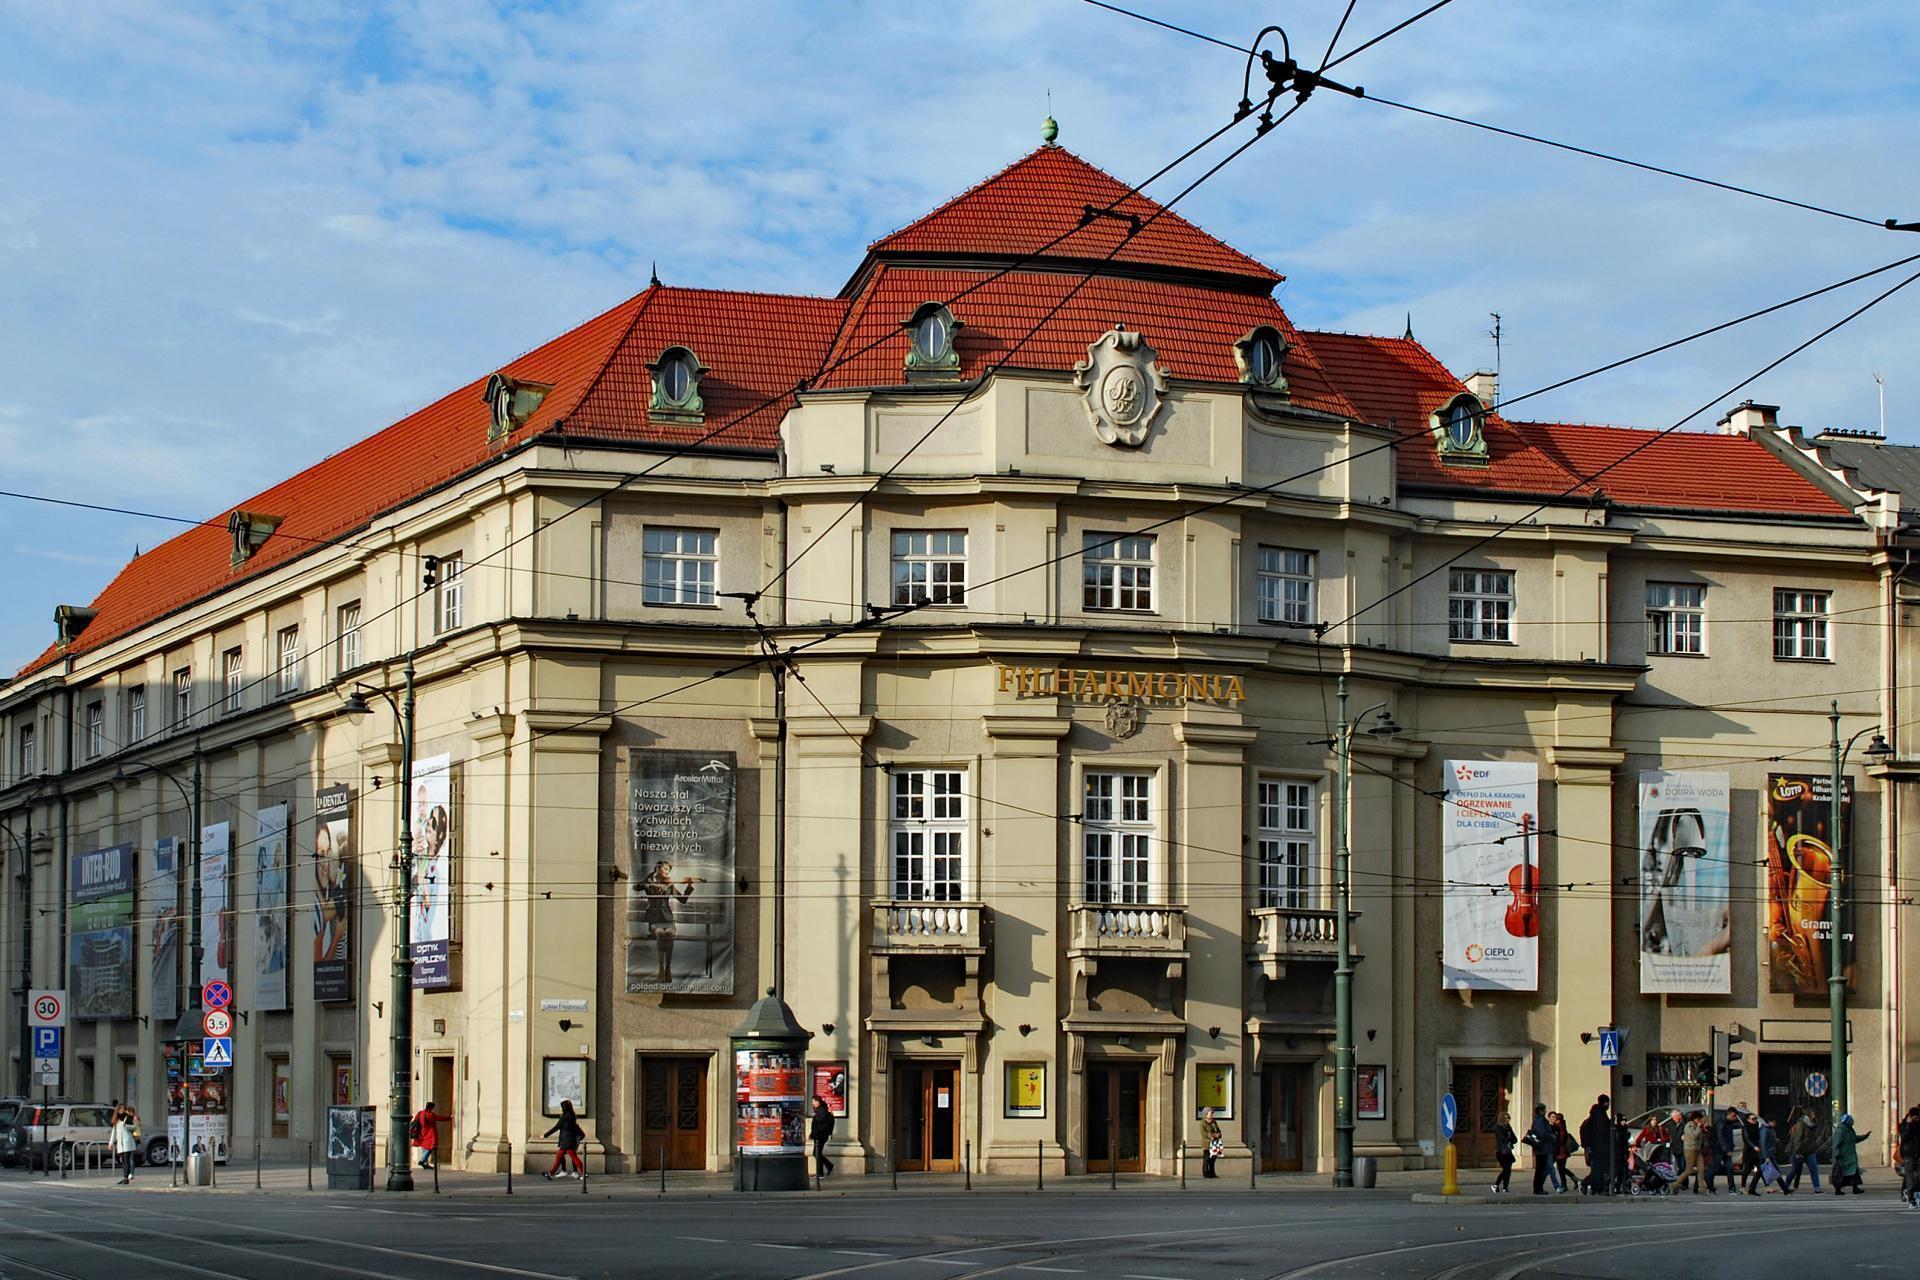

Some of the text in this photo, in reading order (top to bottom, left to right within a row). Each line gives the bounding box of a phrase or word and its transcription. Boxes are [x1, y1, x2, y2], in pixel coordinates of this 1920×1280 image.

[998, 666, 1246, 701] FILHARMONIA
[674, 774, 723, 783] ArcelorMittal
[634, 788, 689, 799] Nasza stal
[1697, 789, 1724, 797] WODA
[1780, 785, 1802, 797] LOTTO
[635, 802, 705, 814] towarzyszy Ci
[1456, 799, 1513, 809] OGRZEWANIE
[1492, 810, 1517, 819] WODA
[634, 815, 692, 825] w chwilach
[1456, 820, 1499, 829] DLA CIEBIE!
[634, 828, 698, 841] codziennych
[1812, 930, 1824, 939] dla
[1484, 948, 1515, 956] CIEPŁO
[39, 1002, 56, 1014] 30
[40, 1029, 55, 1049] P
